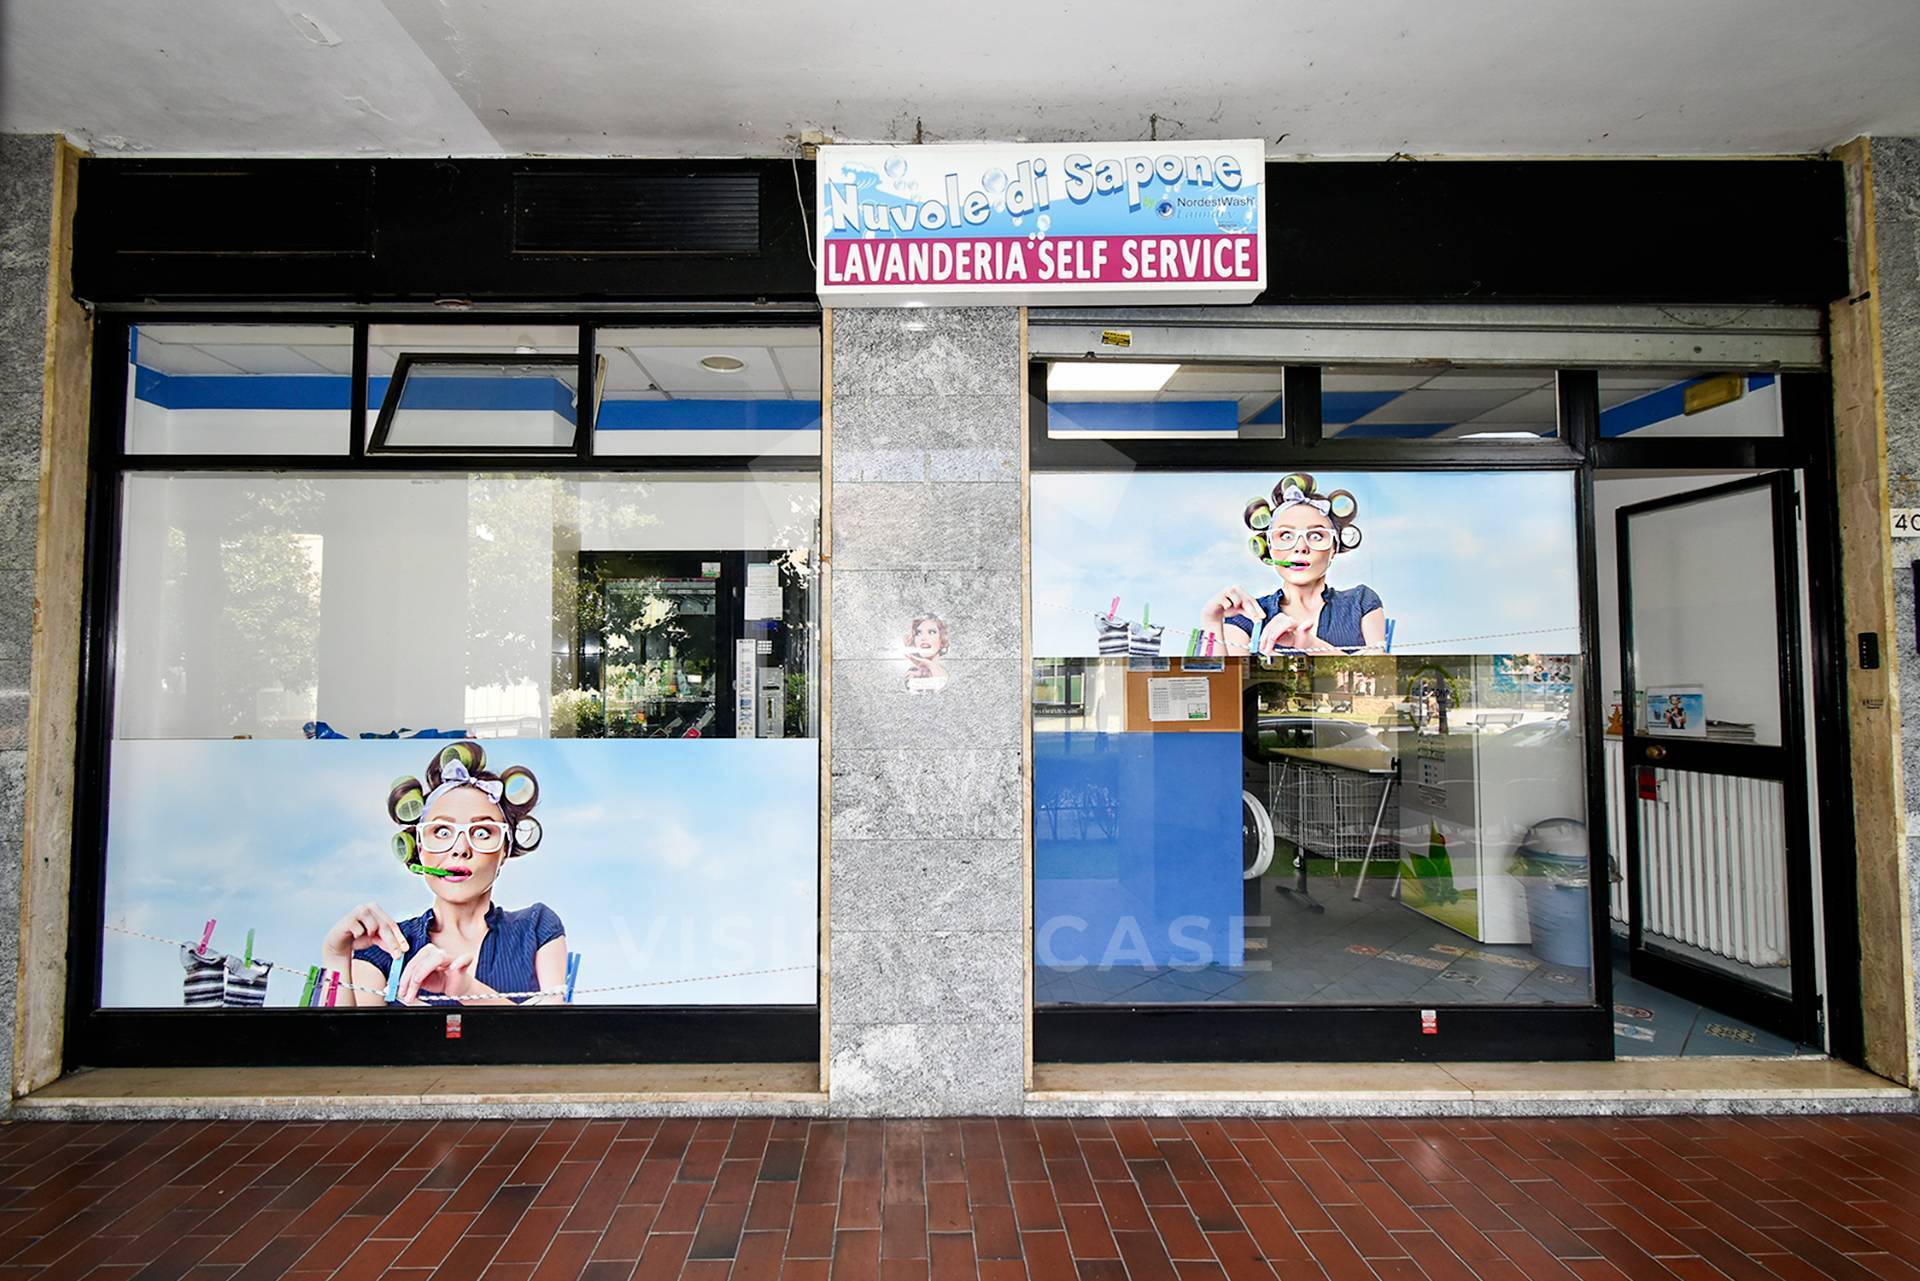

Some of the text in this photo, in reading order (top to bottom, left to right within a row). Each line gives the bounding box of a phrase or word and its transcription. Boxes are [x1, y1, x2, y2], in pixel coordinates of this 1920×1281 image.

[829, 153, 1242, 233] Nuvole di Sapone
[1177, 196, 1254, 207] NordestWash
[828, 238, 1252, 282] LAVANDERIA SELF SERVICE
